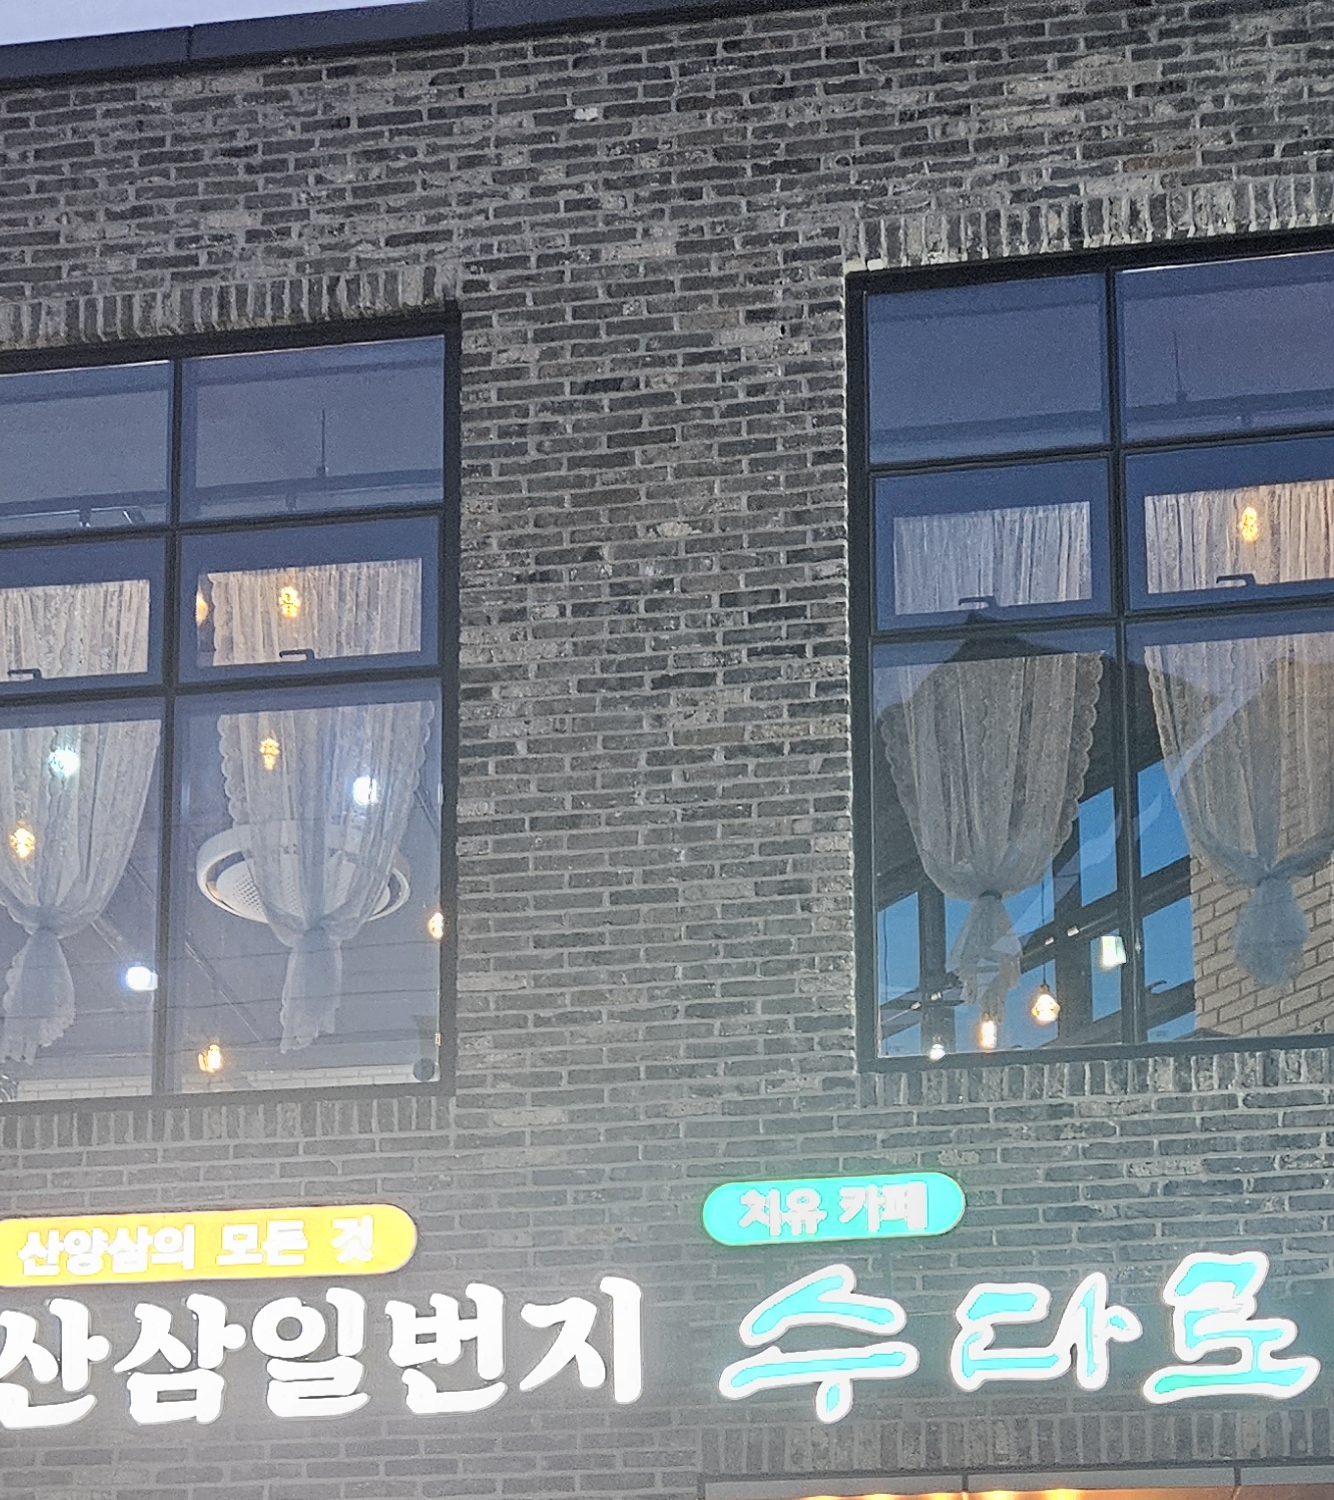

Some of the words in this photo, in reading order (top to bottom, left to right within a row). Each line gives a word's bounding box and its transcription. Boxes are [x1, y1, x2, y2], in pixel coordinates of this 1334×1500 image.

[739, 1188, 828, 1237] 치유
[839, 1181, 927, 1232] 카페
[18, 1223, 196, 1276] 산양삼의
[216, 1219, 309, 1266] 모든
[331, 1215, 374, 1264] 것
